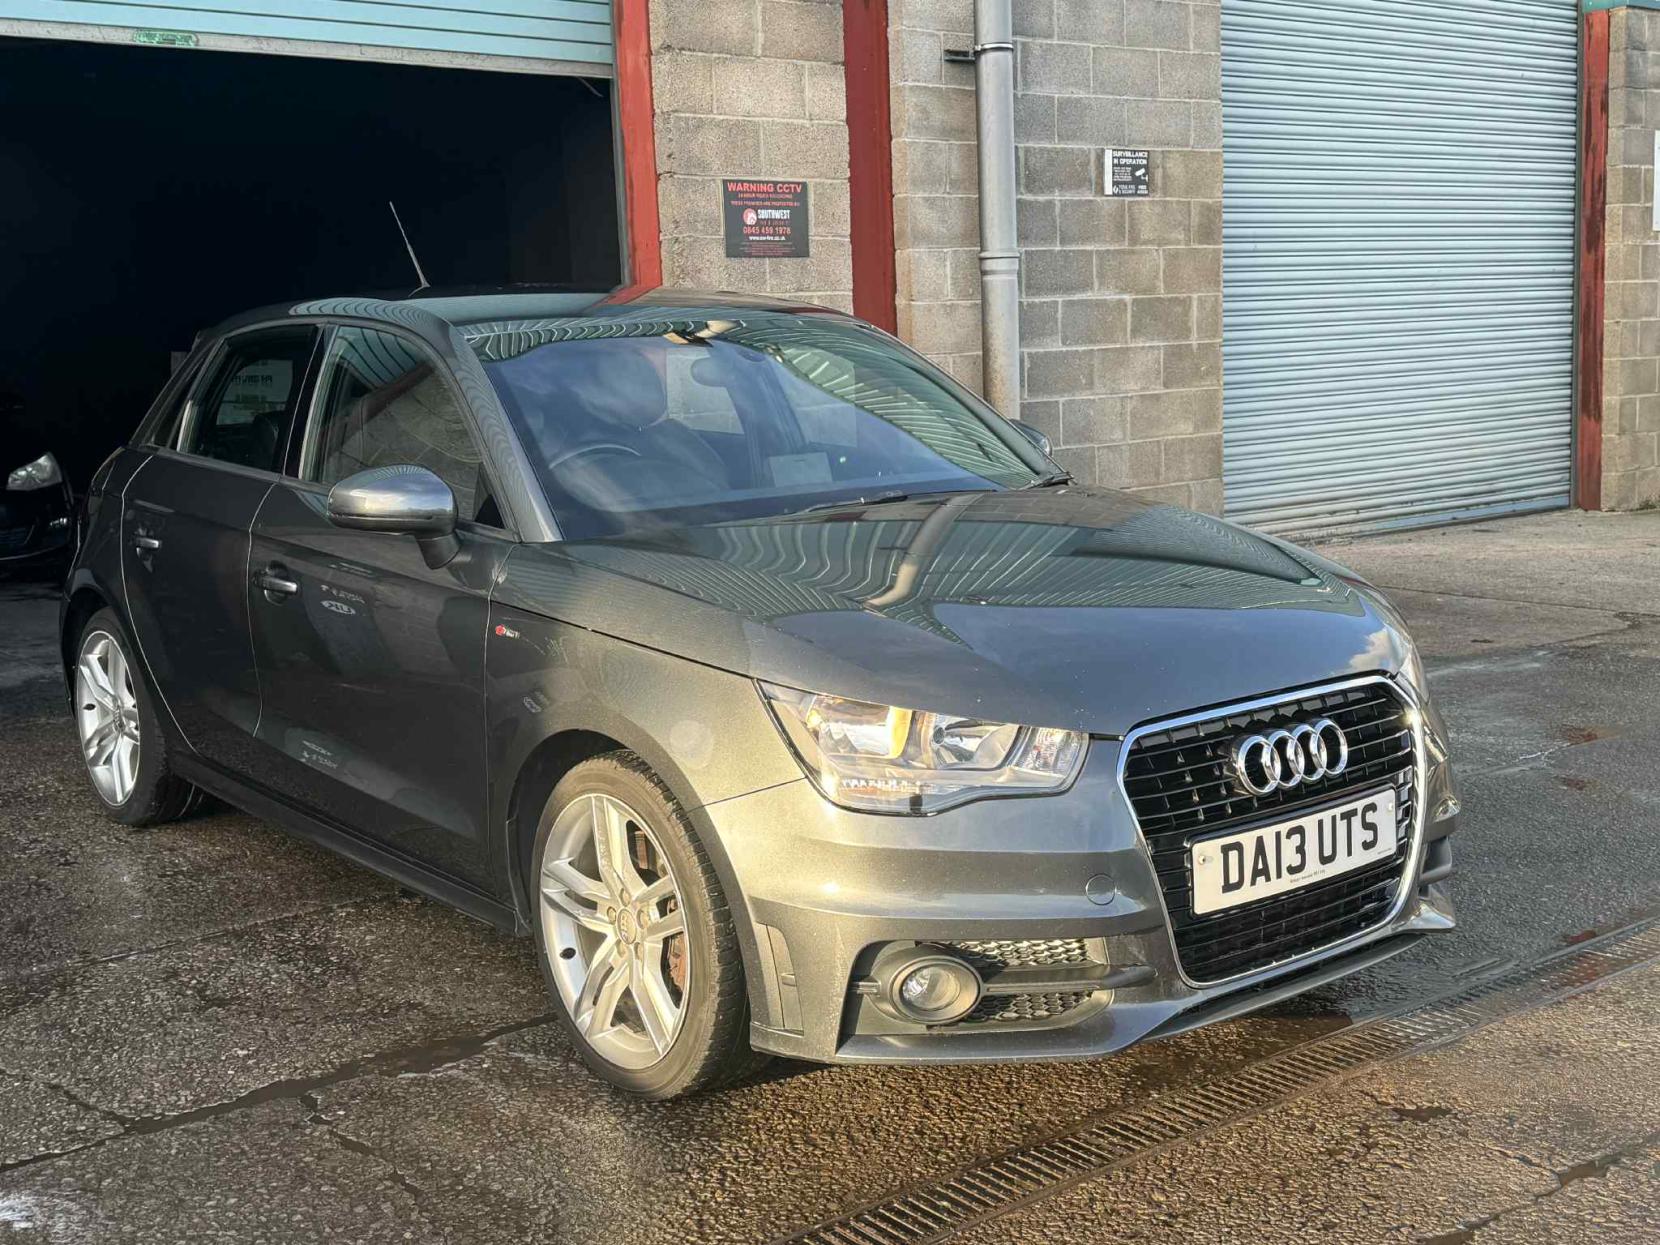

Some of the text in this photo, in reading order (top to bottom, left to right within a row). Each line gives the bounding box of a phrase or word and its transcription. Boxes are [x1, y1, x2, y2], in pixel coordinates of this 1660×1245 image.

[727, 182, 802, 193] WARNING CCTV
[757, 209, 791, 219] SOUTHWEST
[743, 226, 760, 234] 0845
[761, 226, 774, 234] 459
[1220, 802, 1378, 894] DA13 UTS
